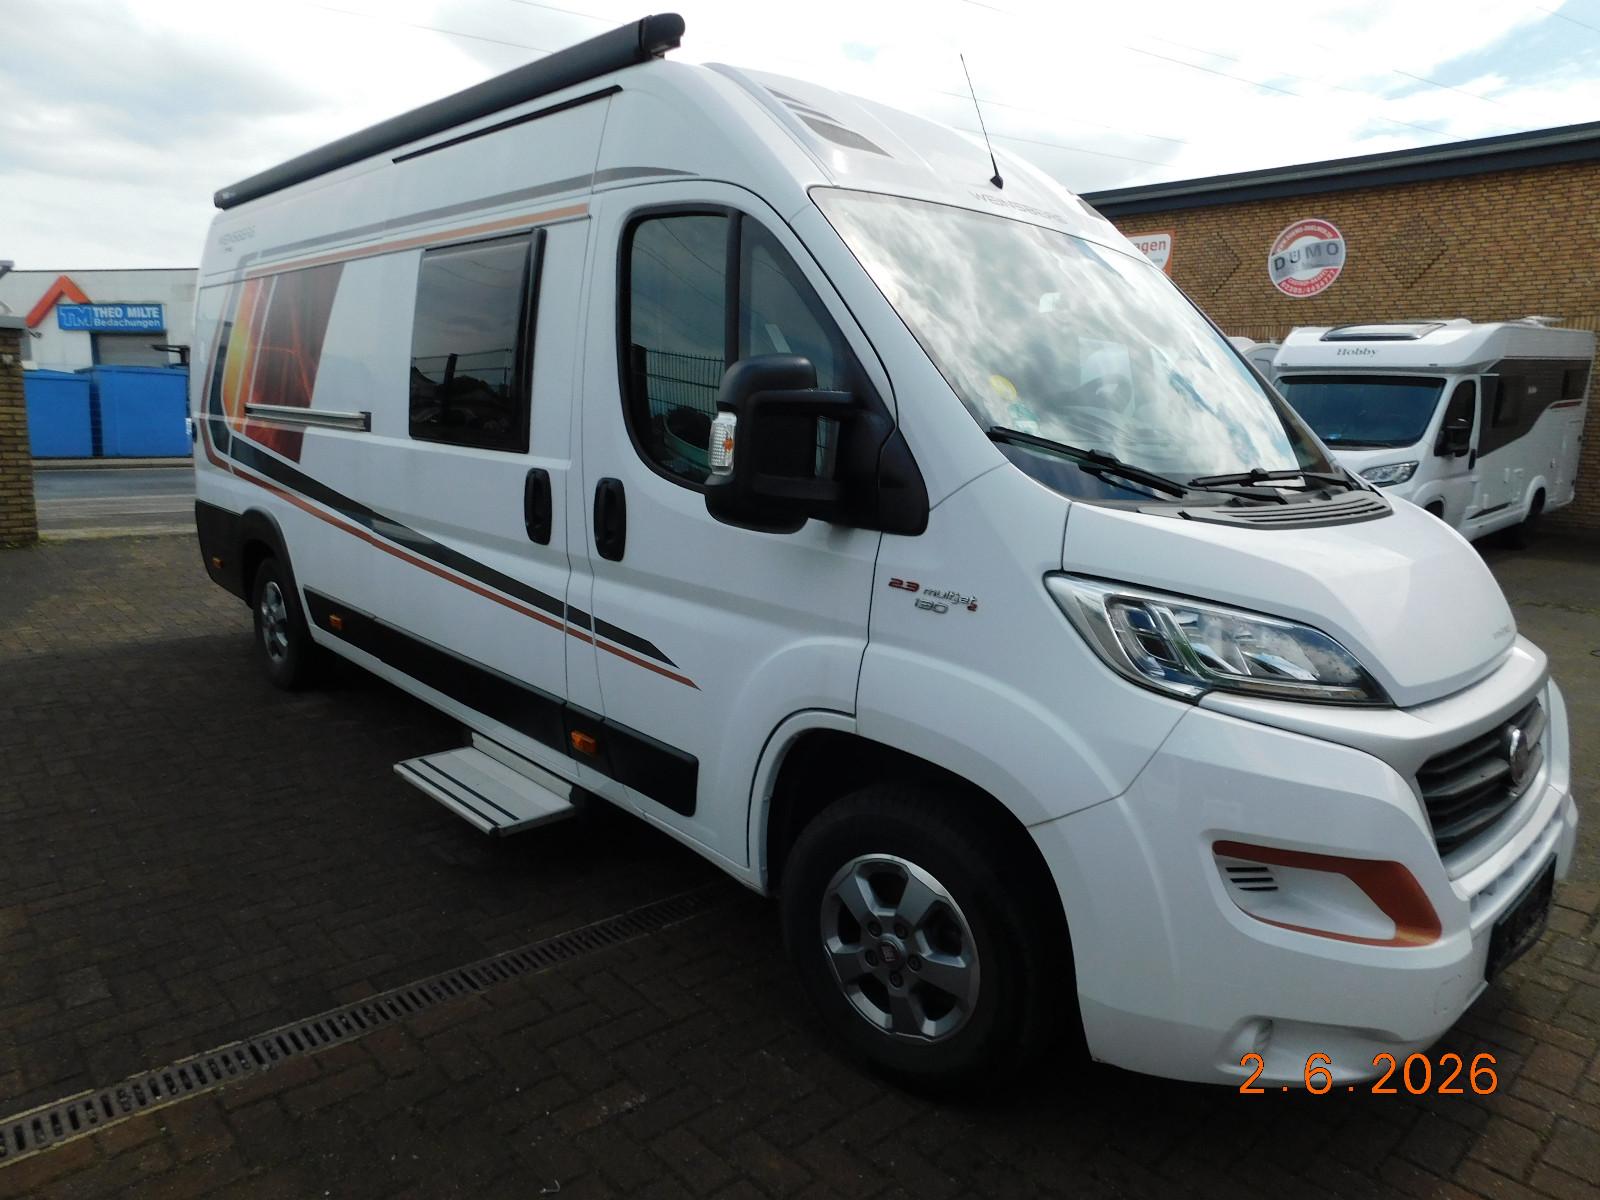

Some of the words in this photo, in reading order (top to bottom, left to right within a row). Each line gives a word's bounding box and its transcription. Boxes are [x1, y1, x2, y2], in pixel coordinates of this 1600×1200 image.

[93, 306, 122, 318] THEO
[127, 306, 160, 318] MILTE
[94, 319, 160, 328] Bedachungen
[1337, 347, 1376, 358] Hobby
